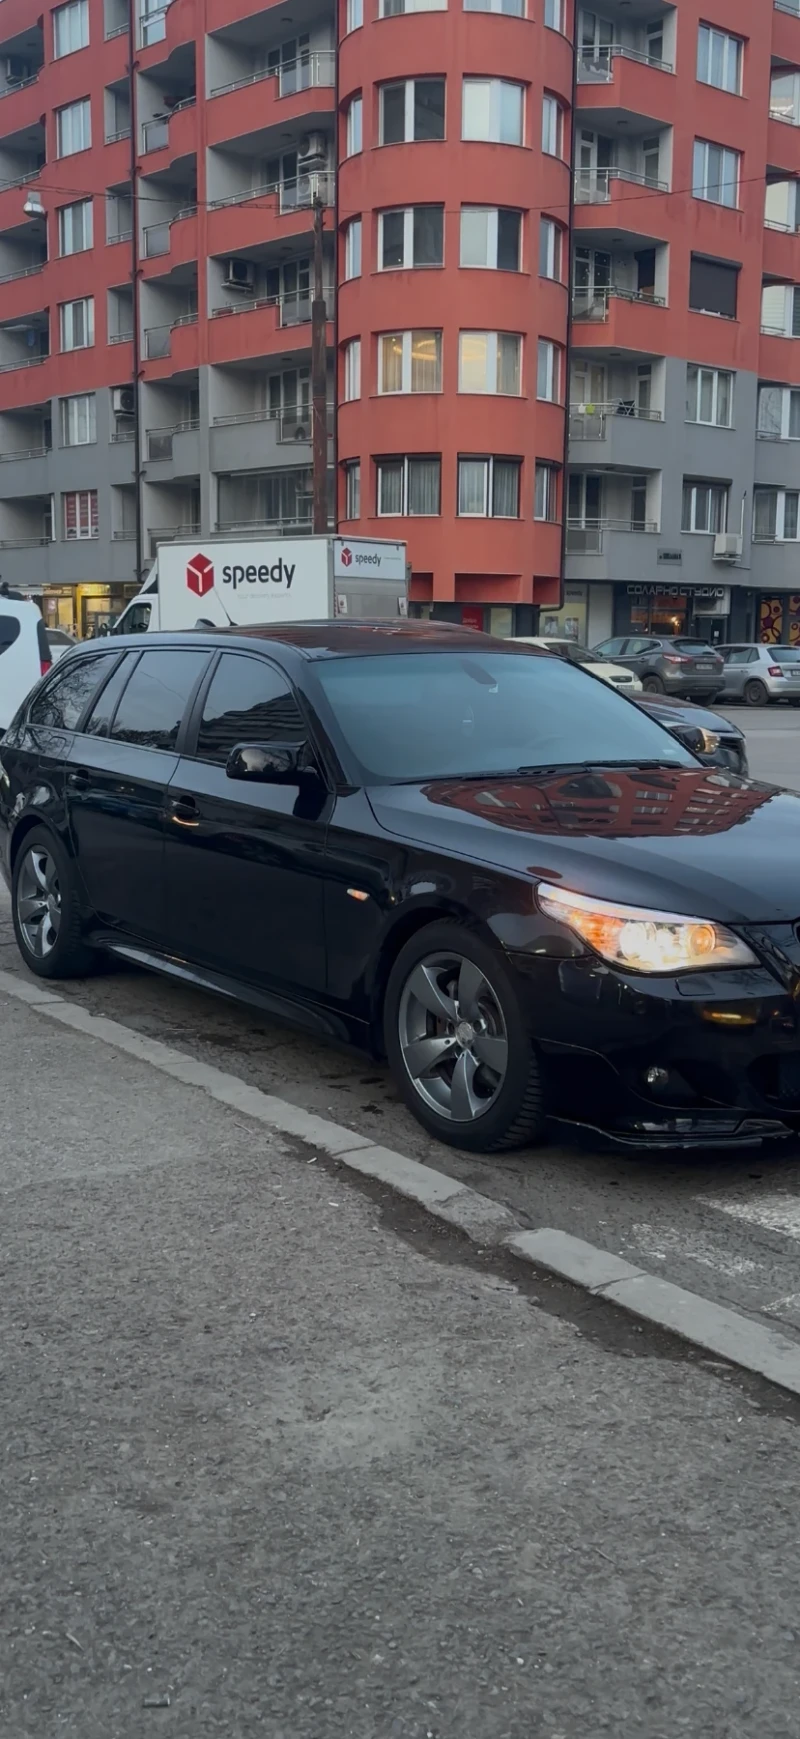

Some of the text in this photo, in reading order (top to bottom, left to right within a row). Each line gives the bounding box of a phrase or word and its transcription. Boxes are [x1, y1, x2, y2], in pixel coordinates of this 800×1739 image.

[355, 553, 381, 567] speedy
[222, 557, 296, 589] speedy
[627, 584, 725, 597] СОЛАРНО СТУДИО
